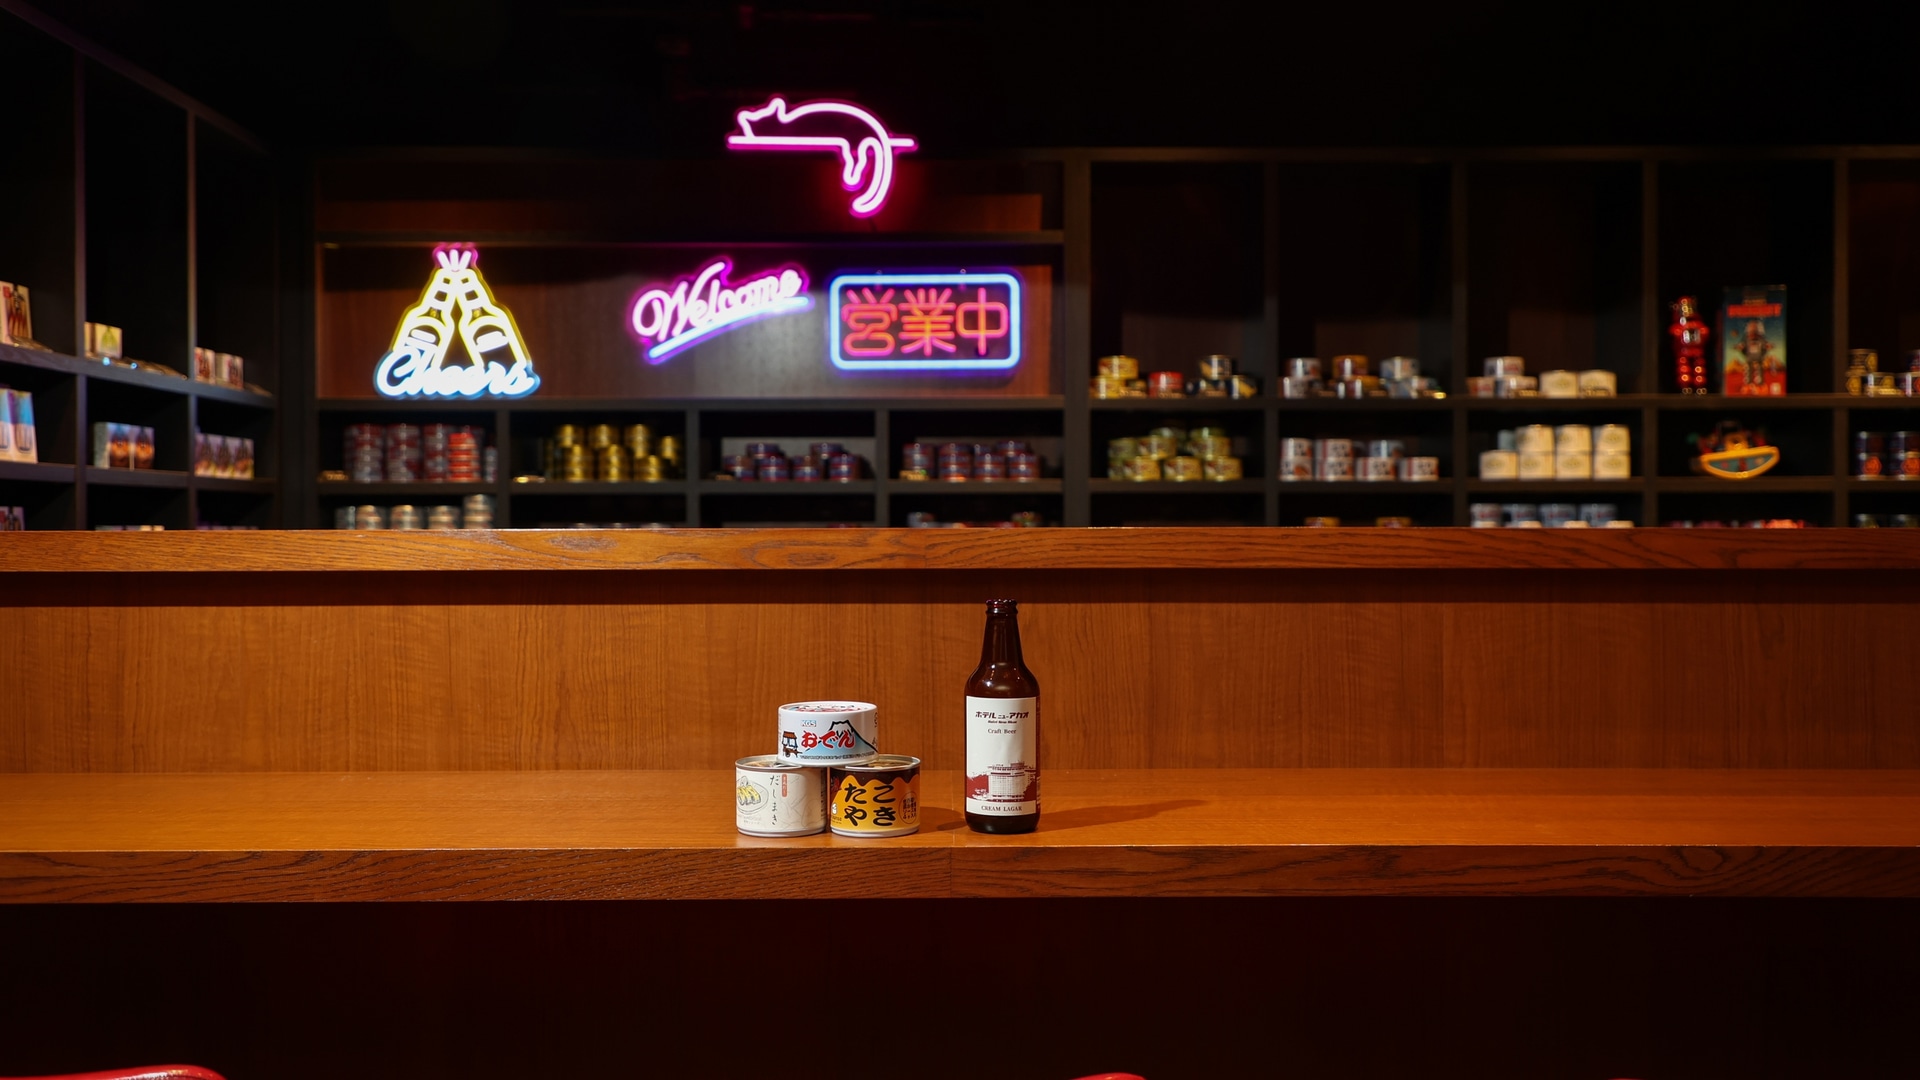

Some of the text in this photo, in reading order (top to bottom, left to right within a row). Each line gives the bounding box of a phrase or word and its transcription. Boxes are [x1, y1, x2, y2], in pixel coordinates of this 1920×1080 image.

[631, 261, 803, 342] Welcome
[840, 286, 1010, 357] 営業中
[375, 347, 541, 397] Cheers
[801, 730, 855, 749] おでん
[770, 775, 780, 826] だしまき
